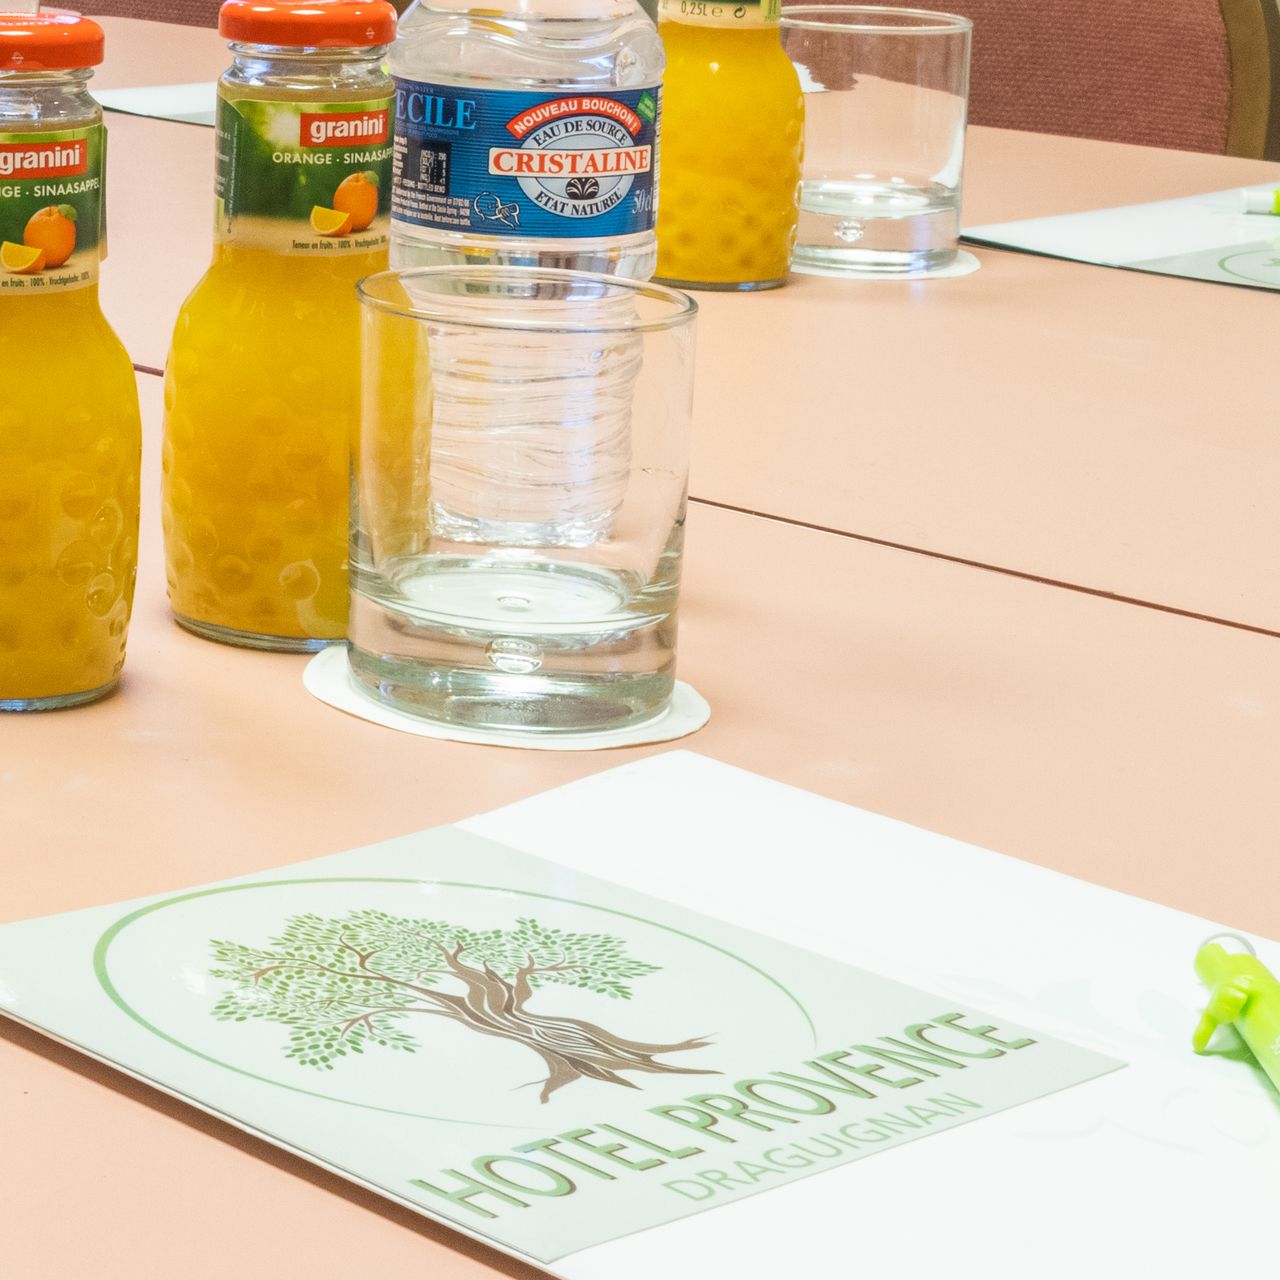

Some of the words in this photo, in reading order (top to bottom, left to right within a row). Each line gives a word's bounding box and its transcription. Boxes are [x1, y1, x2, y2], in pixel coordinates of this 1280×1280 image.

[681, 0, 708, 16] 0,25L
[395, 88, 477, 130] ECILE
[513, 100, 578, 134] NOUVEAU
[582, 99, 635, 125] BOUCHON
[309, 114, 384, 144] granini
[531, 124, 561, 147] EAU
[564, 120, 584, 134] DE
[585, 119, 628, 146] SOURCE
[272, 151, 332, 165] ORANGE
[492, 149, 649, 174] CRISTALINE
[32, 177, 101, 198] SINAASAPPEL
[534, 190, 569, 216] ETAT
[571, 190, 623, 216] NATUREL
[407, 1122, 704, 1220] HOTEL
[646, 1011, 1039, 1144] PROVENCE
[661, 1091, 985, 1205] DRAGUIGNAN
